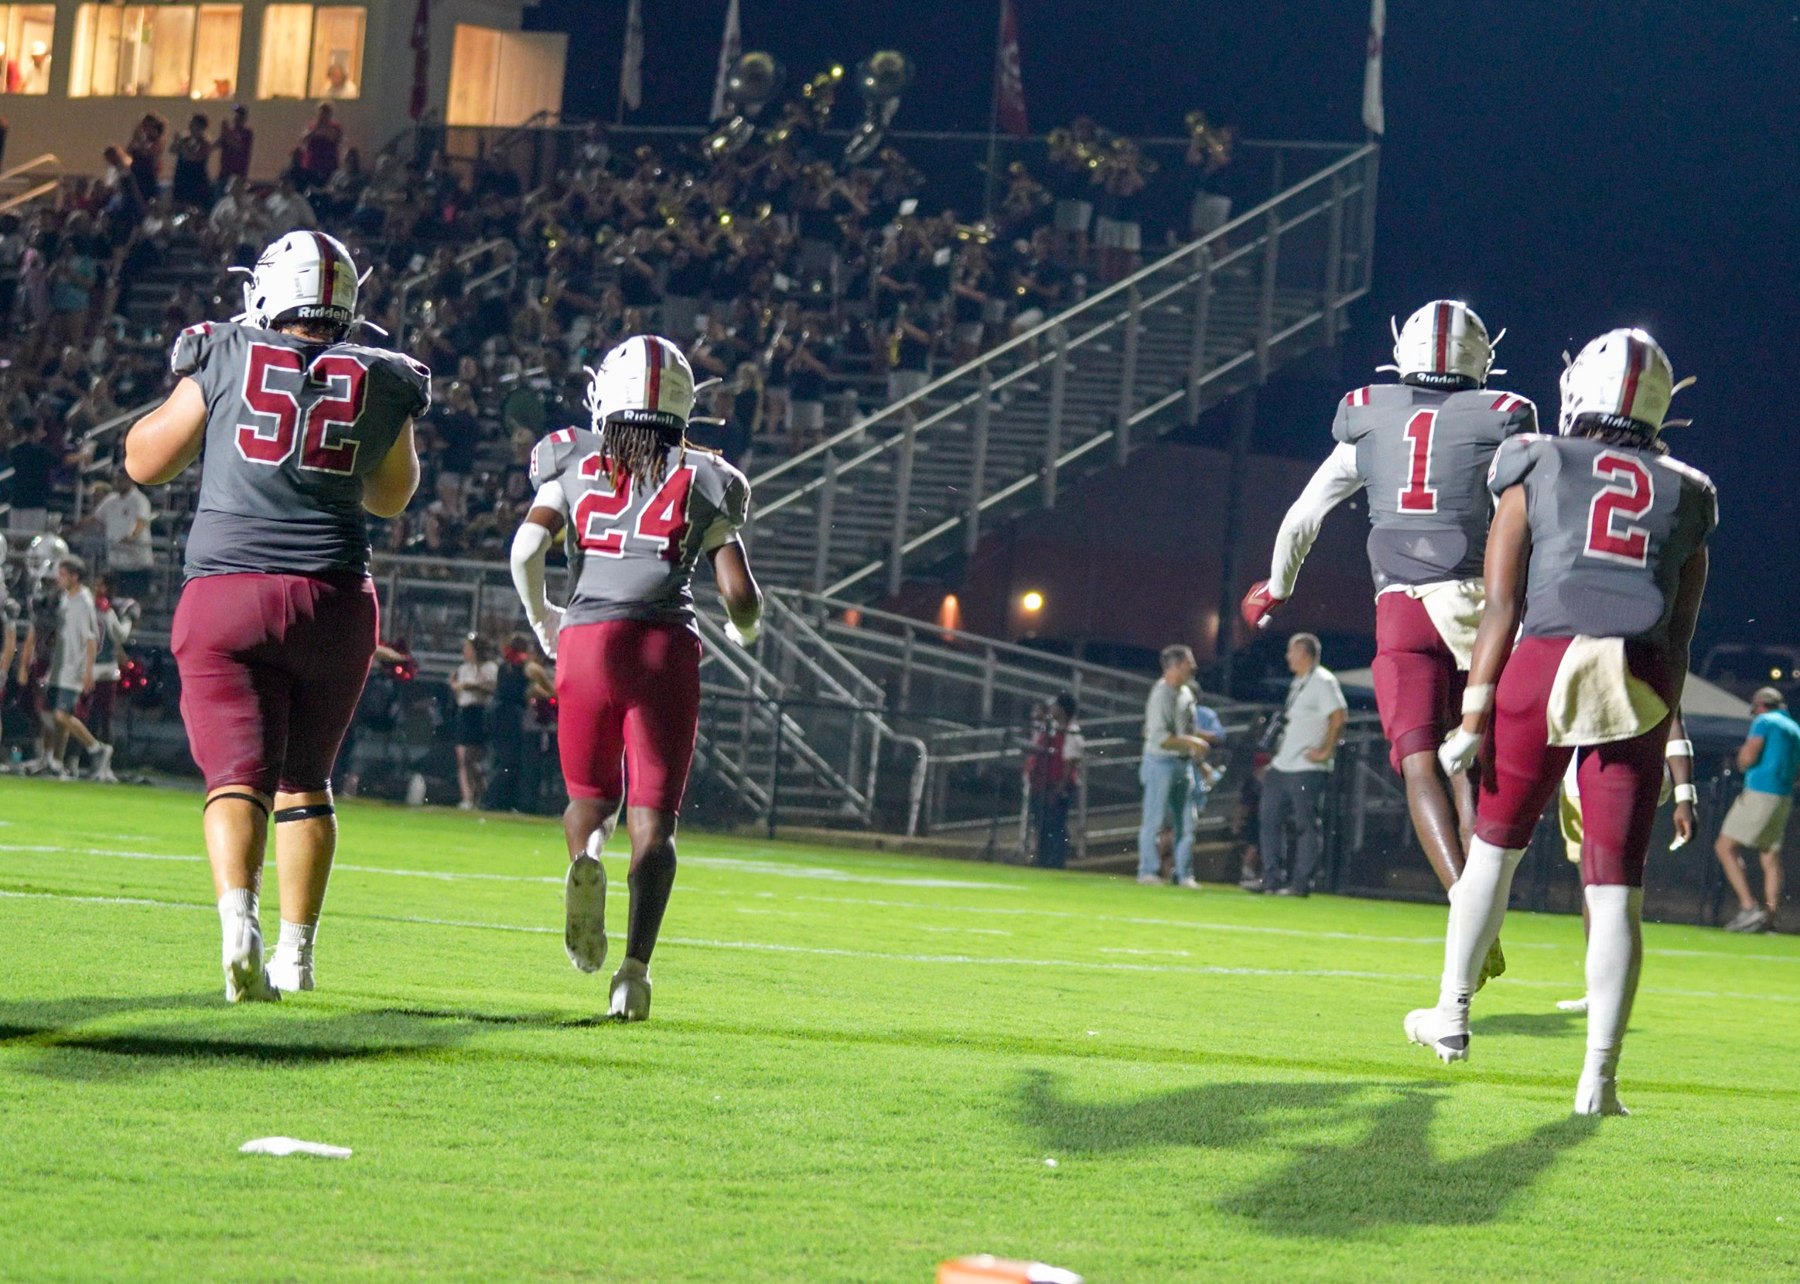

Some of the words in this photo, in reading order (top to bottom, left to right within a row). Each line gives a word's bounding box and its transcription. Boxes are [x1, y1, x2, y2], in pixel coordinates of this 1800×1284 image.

[298, 306, 348, 320] Riddell
[235, 342, 368, 475] 52
[1398, 408, 1439, 514] 1
[574, 452, 697, 560] 24
[1584, 449, 1654, 567] 2
